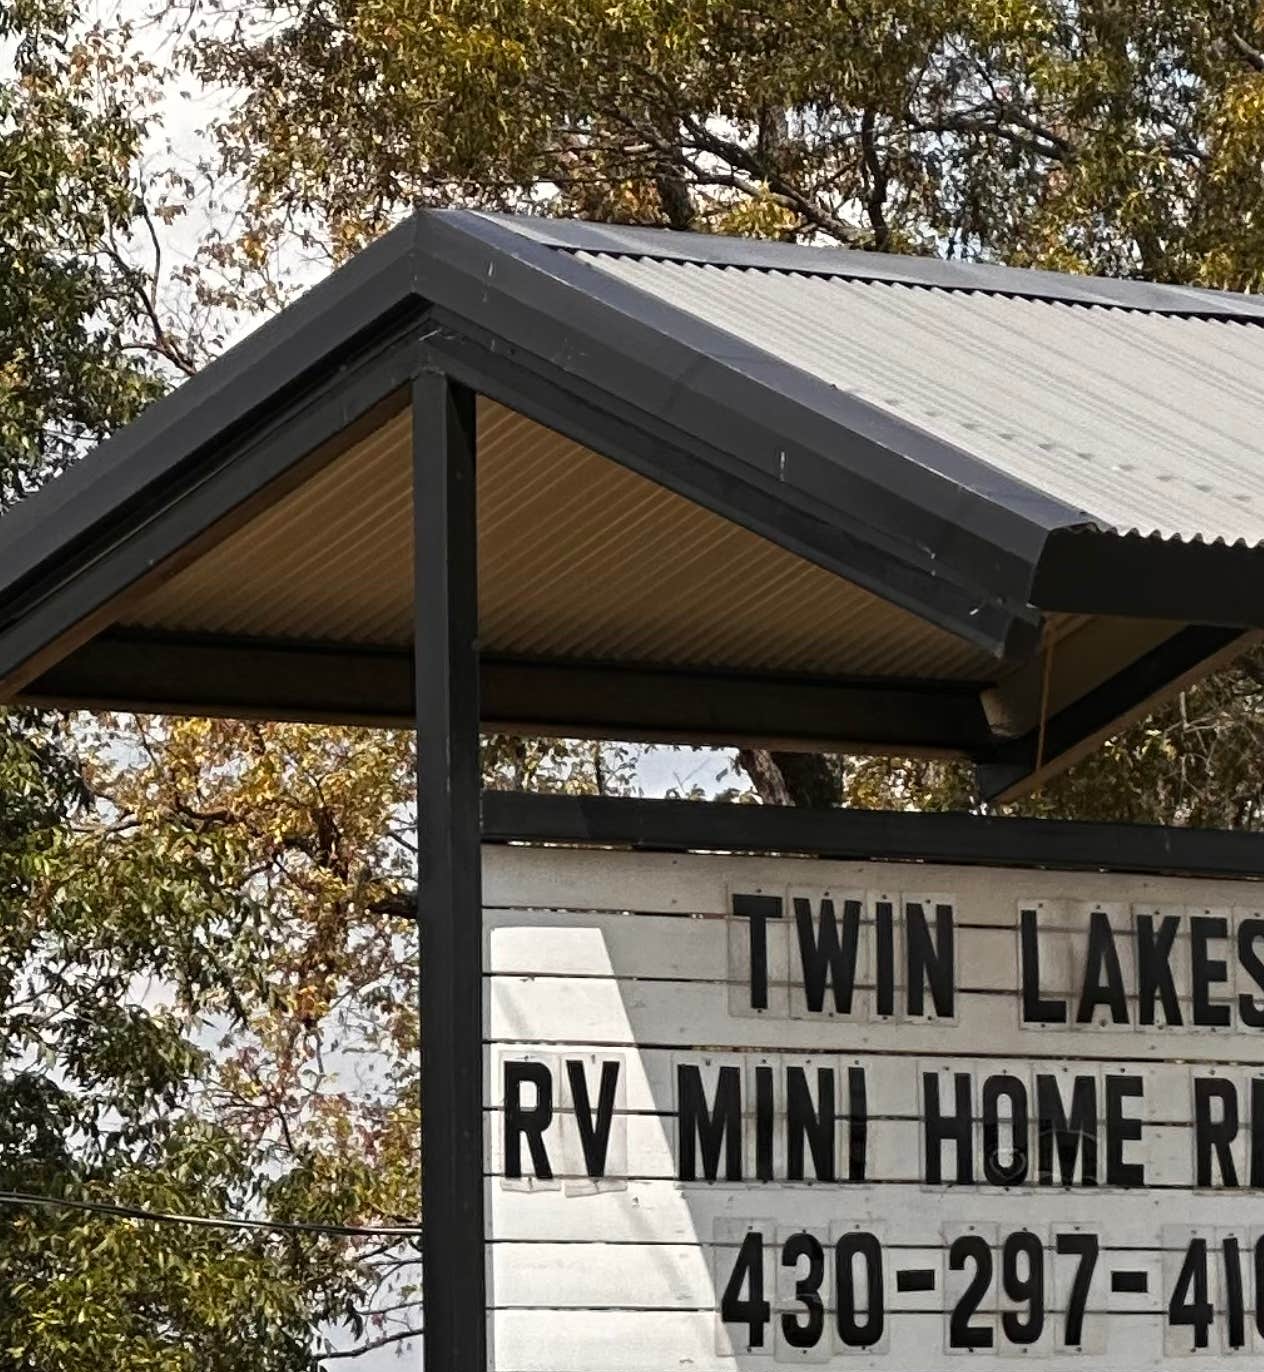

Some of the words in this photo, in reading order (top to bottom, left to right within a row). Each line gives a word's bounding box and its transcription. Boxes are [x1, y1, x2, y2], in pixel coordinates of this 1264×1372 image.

[731, 893, 956, 1018] TWIN
[502, 1059, 620, 1180] RV
[677, 1063, 868, 1183] MINI
[923, 1071, 1145, 1188] HOME
